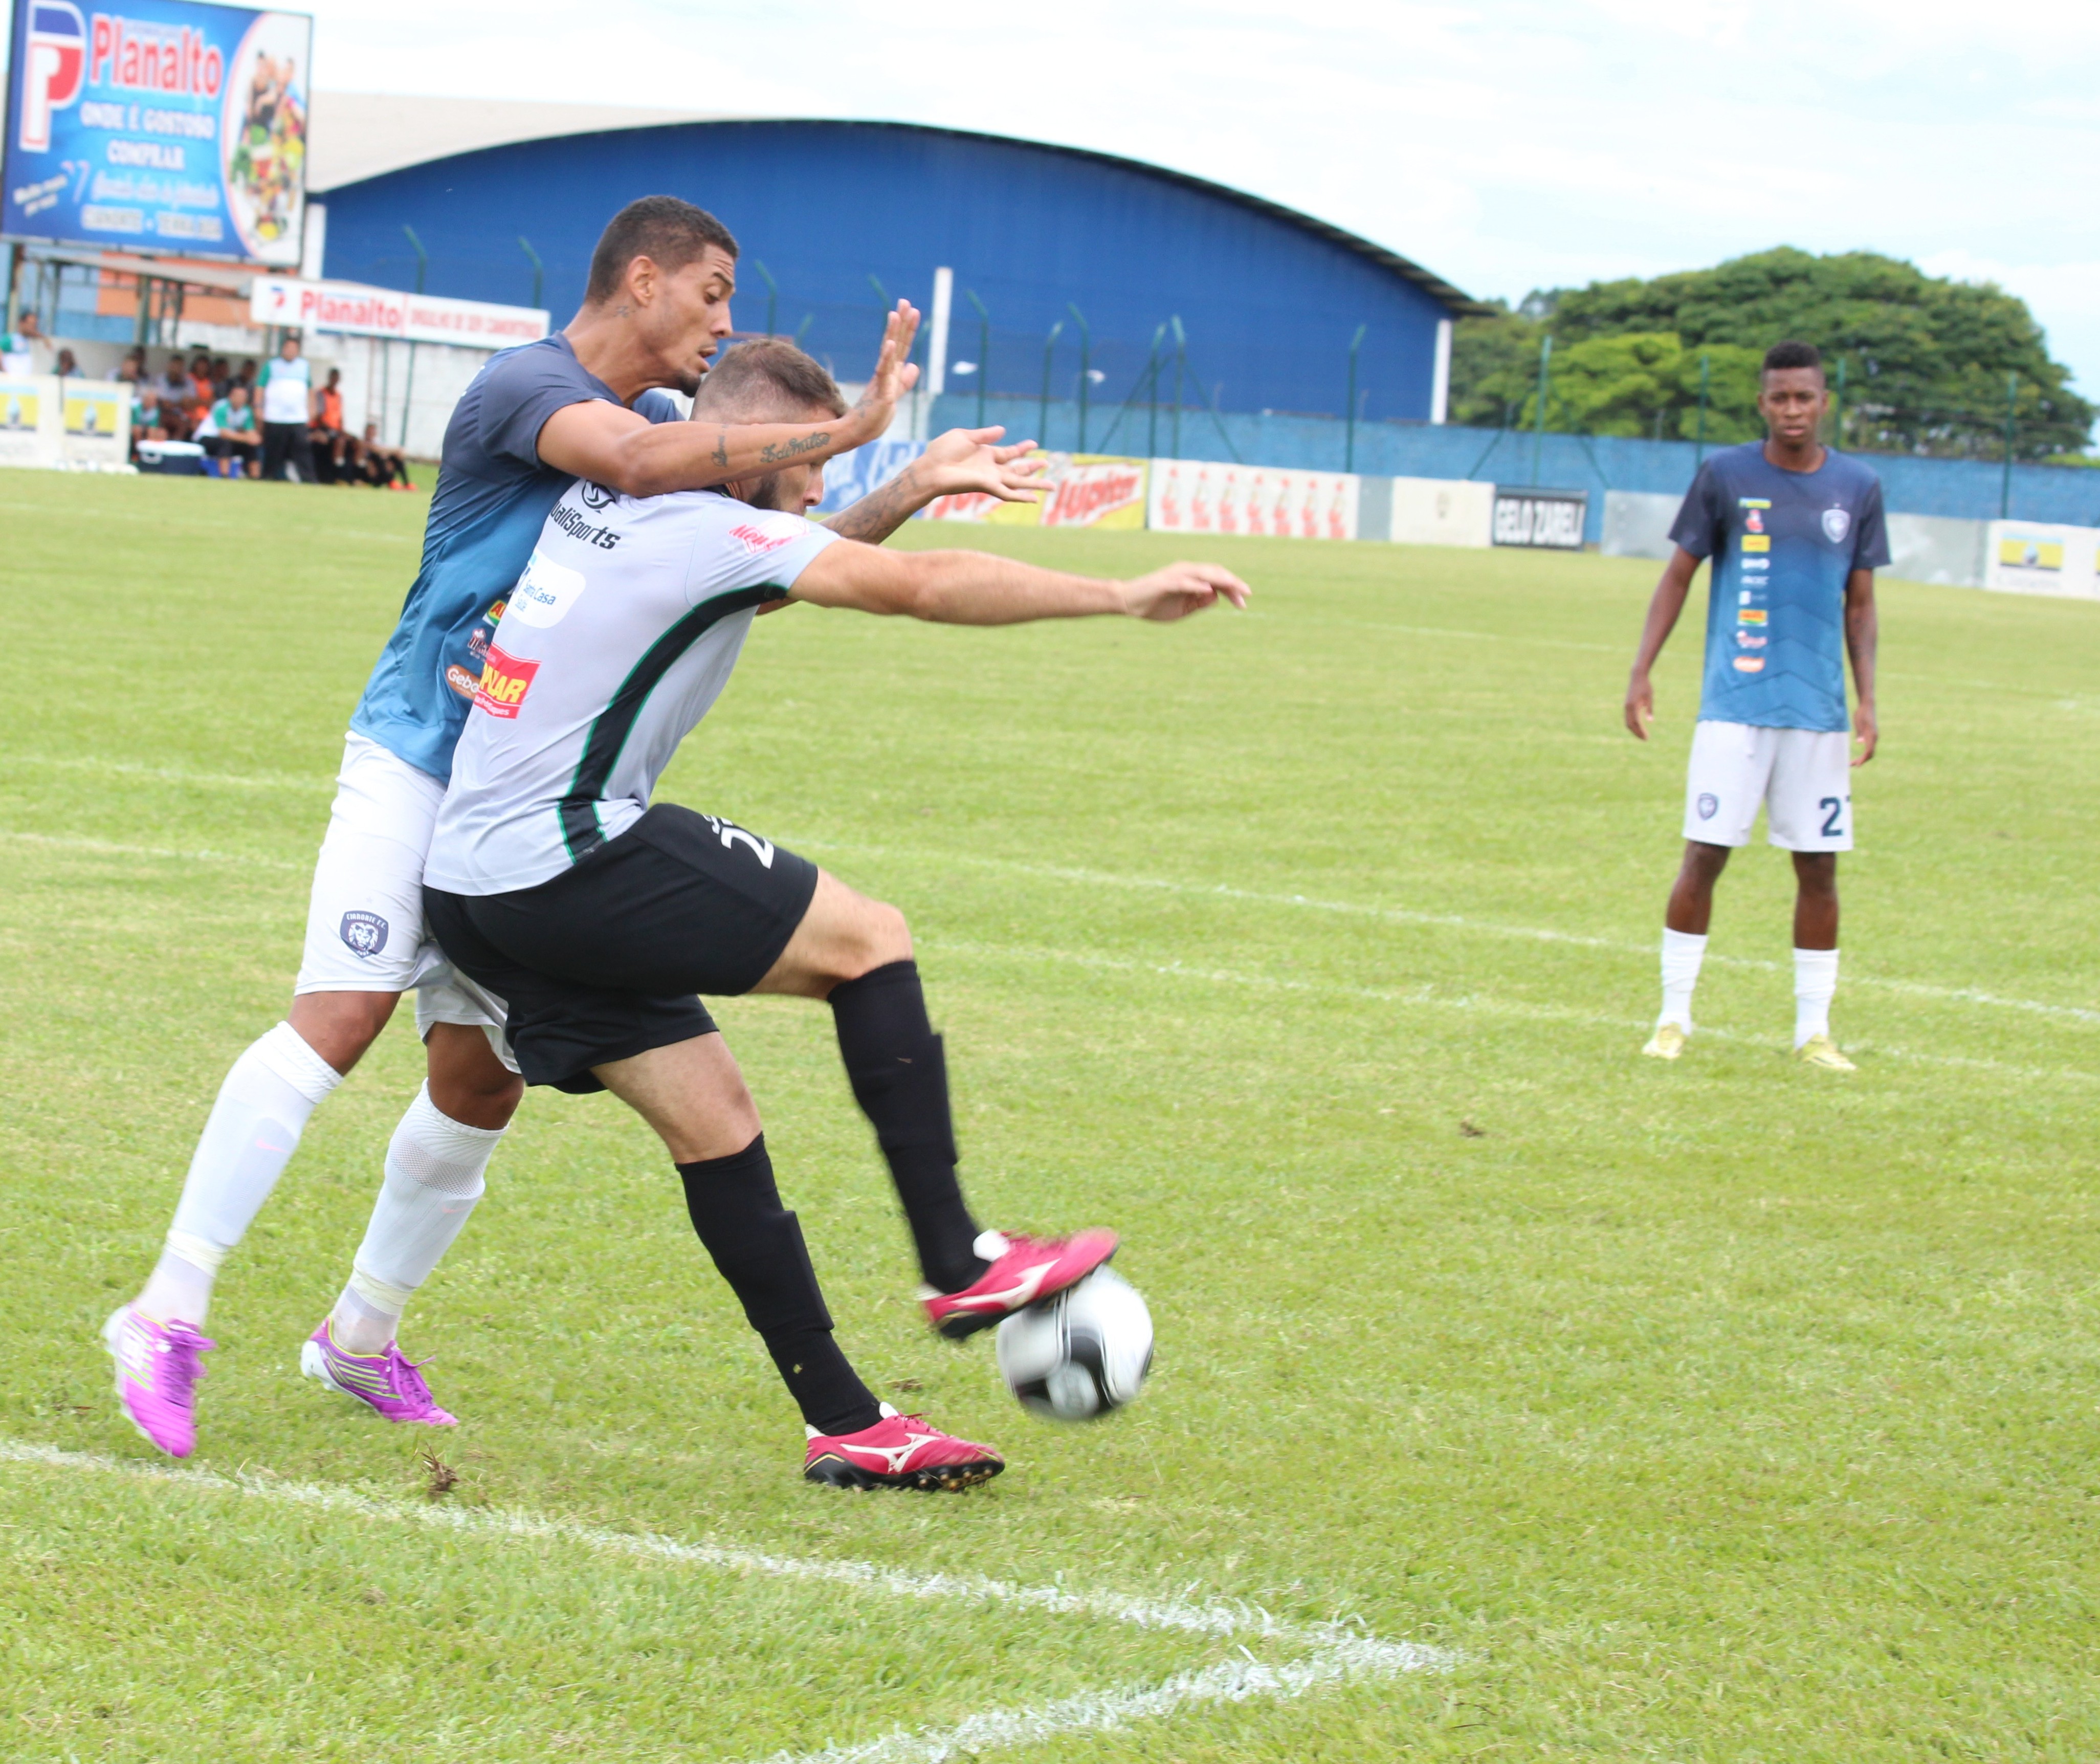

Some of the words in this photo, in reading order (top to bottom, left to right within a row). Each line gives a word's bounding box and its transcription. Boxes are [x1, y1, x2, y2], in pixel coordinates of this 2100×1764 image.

[89, 12, 224, 98] Planalto
[299, 289, 400, 329] Planalto
[550, 500, 621, 550] ualiSports
[533, 587, 556, 605] Casa
[448, 668, 480, 694] Gebo
[1819, 795, 1851, 837] 2
